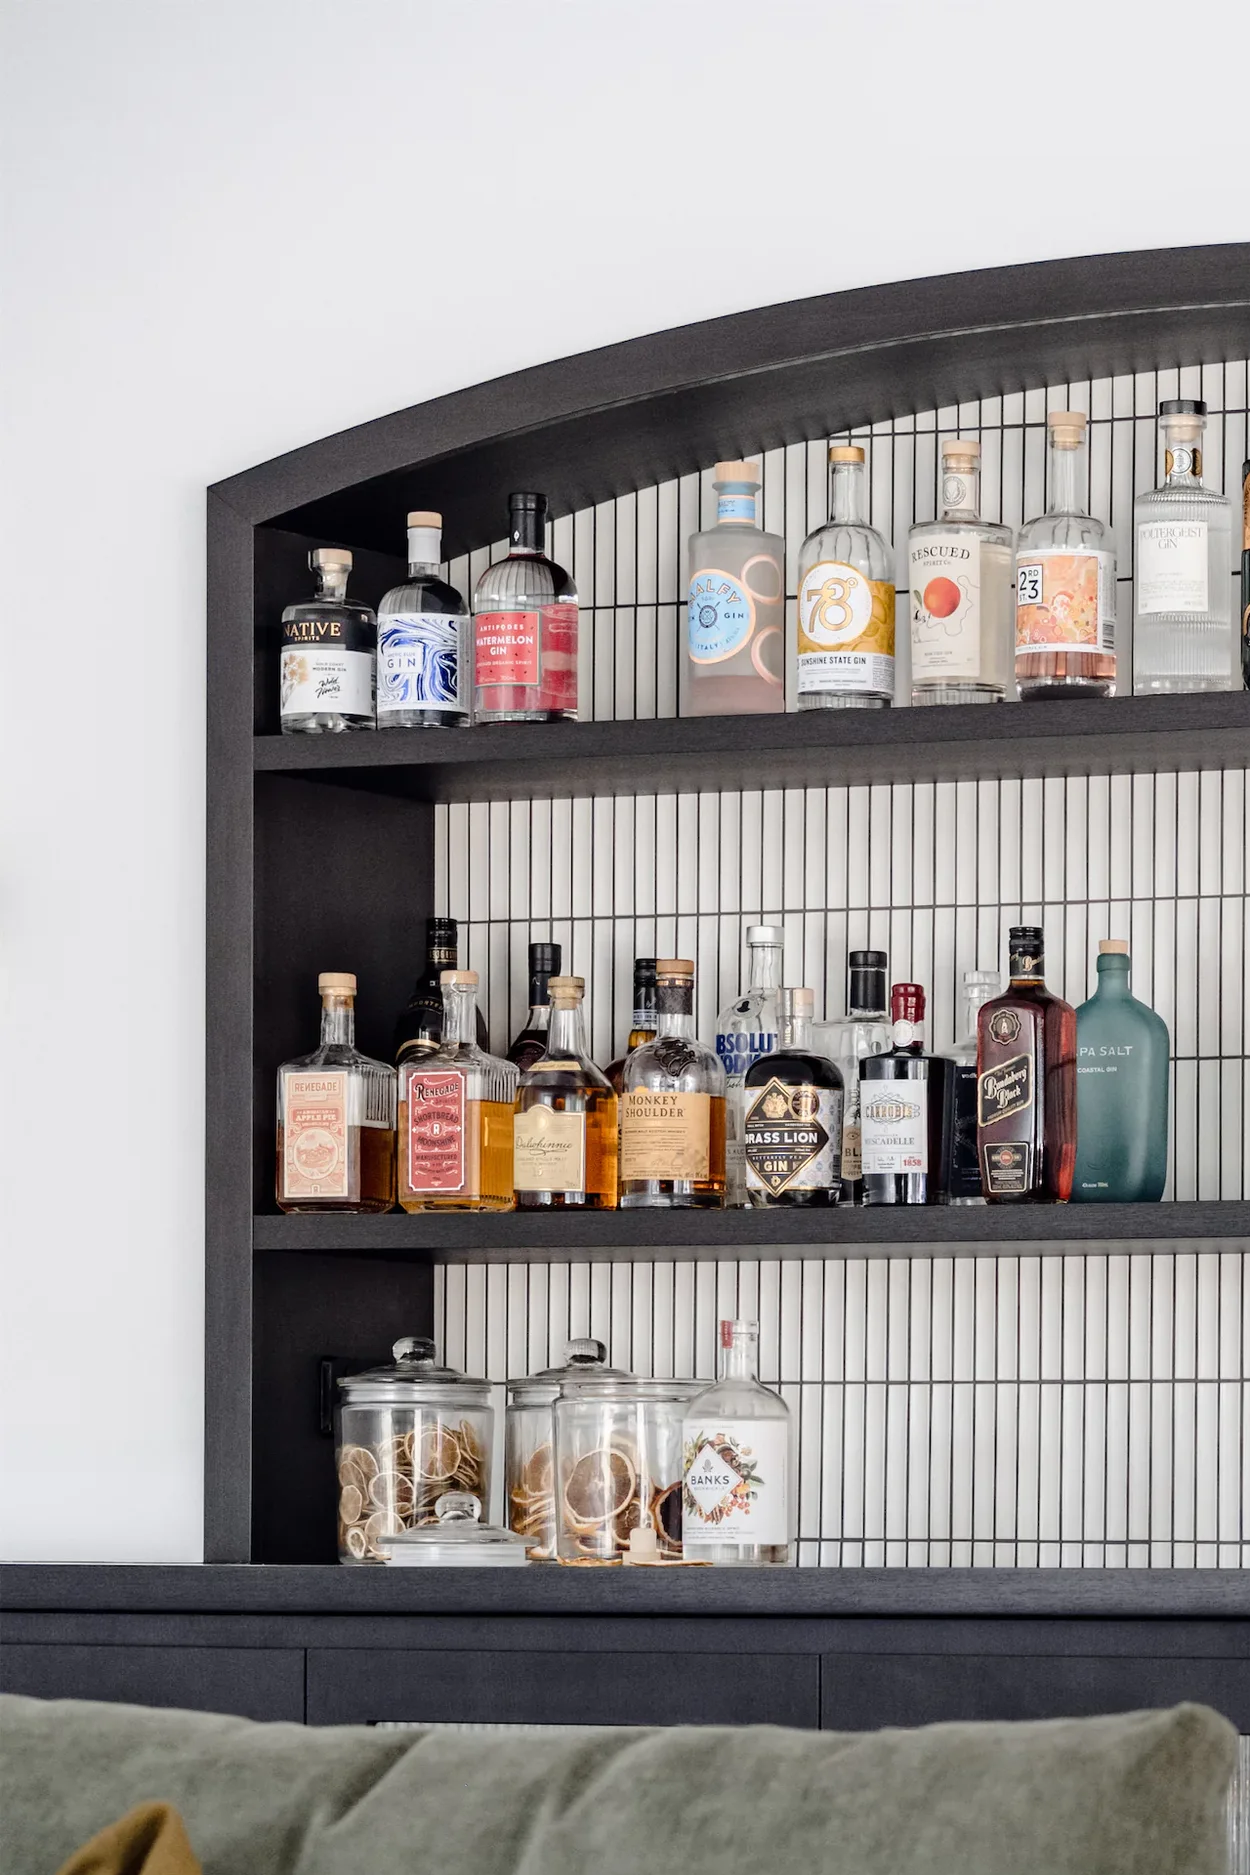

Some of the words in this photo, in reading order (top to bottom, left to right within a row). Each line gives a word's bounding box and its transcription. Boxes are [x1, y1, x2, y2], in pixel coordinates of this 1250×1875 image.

[1141, 526, 1203, 540] POLTERGEIST
[1158, 538, 1178, 549] GIN
[911, 545, 970, 563] RESCUED
[1019, 571, 1027, 591] 2
[1028, 579, 1039, 599] 3
[285, 622, 341, 636] NATIVE
[476, 635, 533, 646] WATERMELON
[490, 646, 507, 655] GIN
[387, 658, 416, 668] GIN
[801, 656, 827, 667] SUNSHINE
[829, 656, 851, 664] STATE
[853, 657, 867, 665] GIN
[716, 1032, 778, 1055] BSOLU
[1099, 1046, 1133, 1056] SALT
[295, 1082, 337, 1092] RENEGADE
[984, 1067, 1027, 1099] Bundaberg
[414, 1082, 459, 1100] RENEGADE
[628, 1095, 677, 1105] MONKEY
[997, 1085, 1021, 1109] Black
[414, 1111, 459, 1125] SHORTBREAD
[626, 1108, 684, 1118] SHOULDER
[417, 1135, 456, 1146] MOONSHINE
[745, 1132, 780, 1143] BRASS
[784, 1132, 818, 1143] LION
[764, 1160, 788, 1171] GIN
[904, 1159, 921, 1167] 1858
[691, 1476, 730, 1485] BANKS
